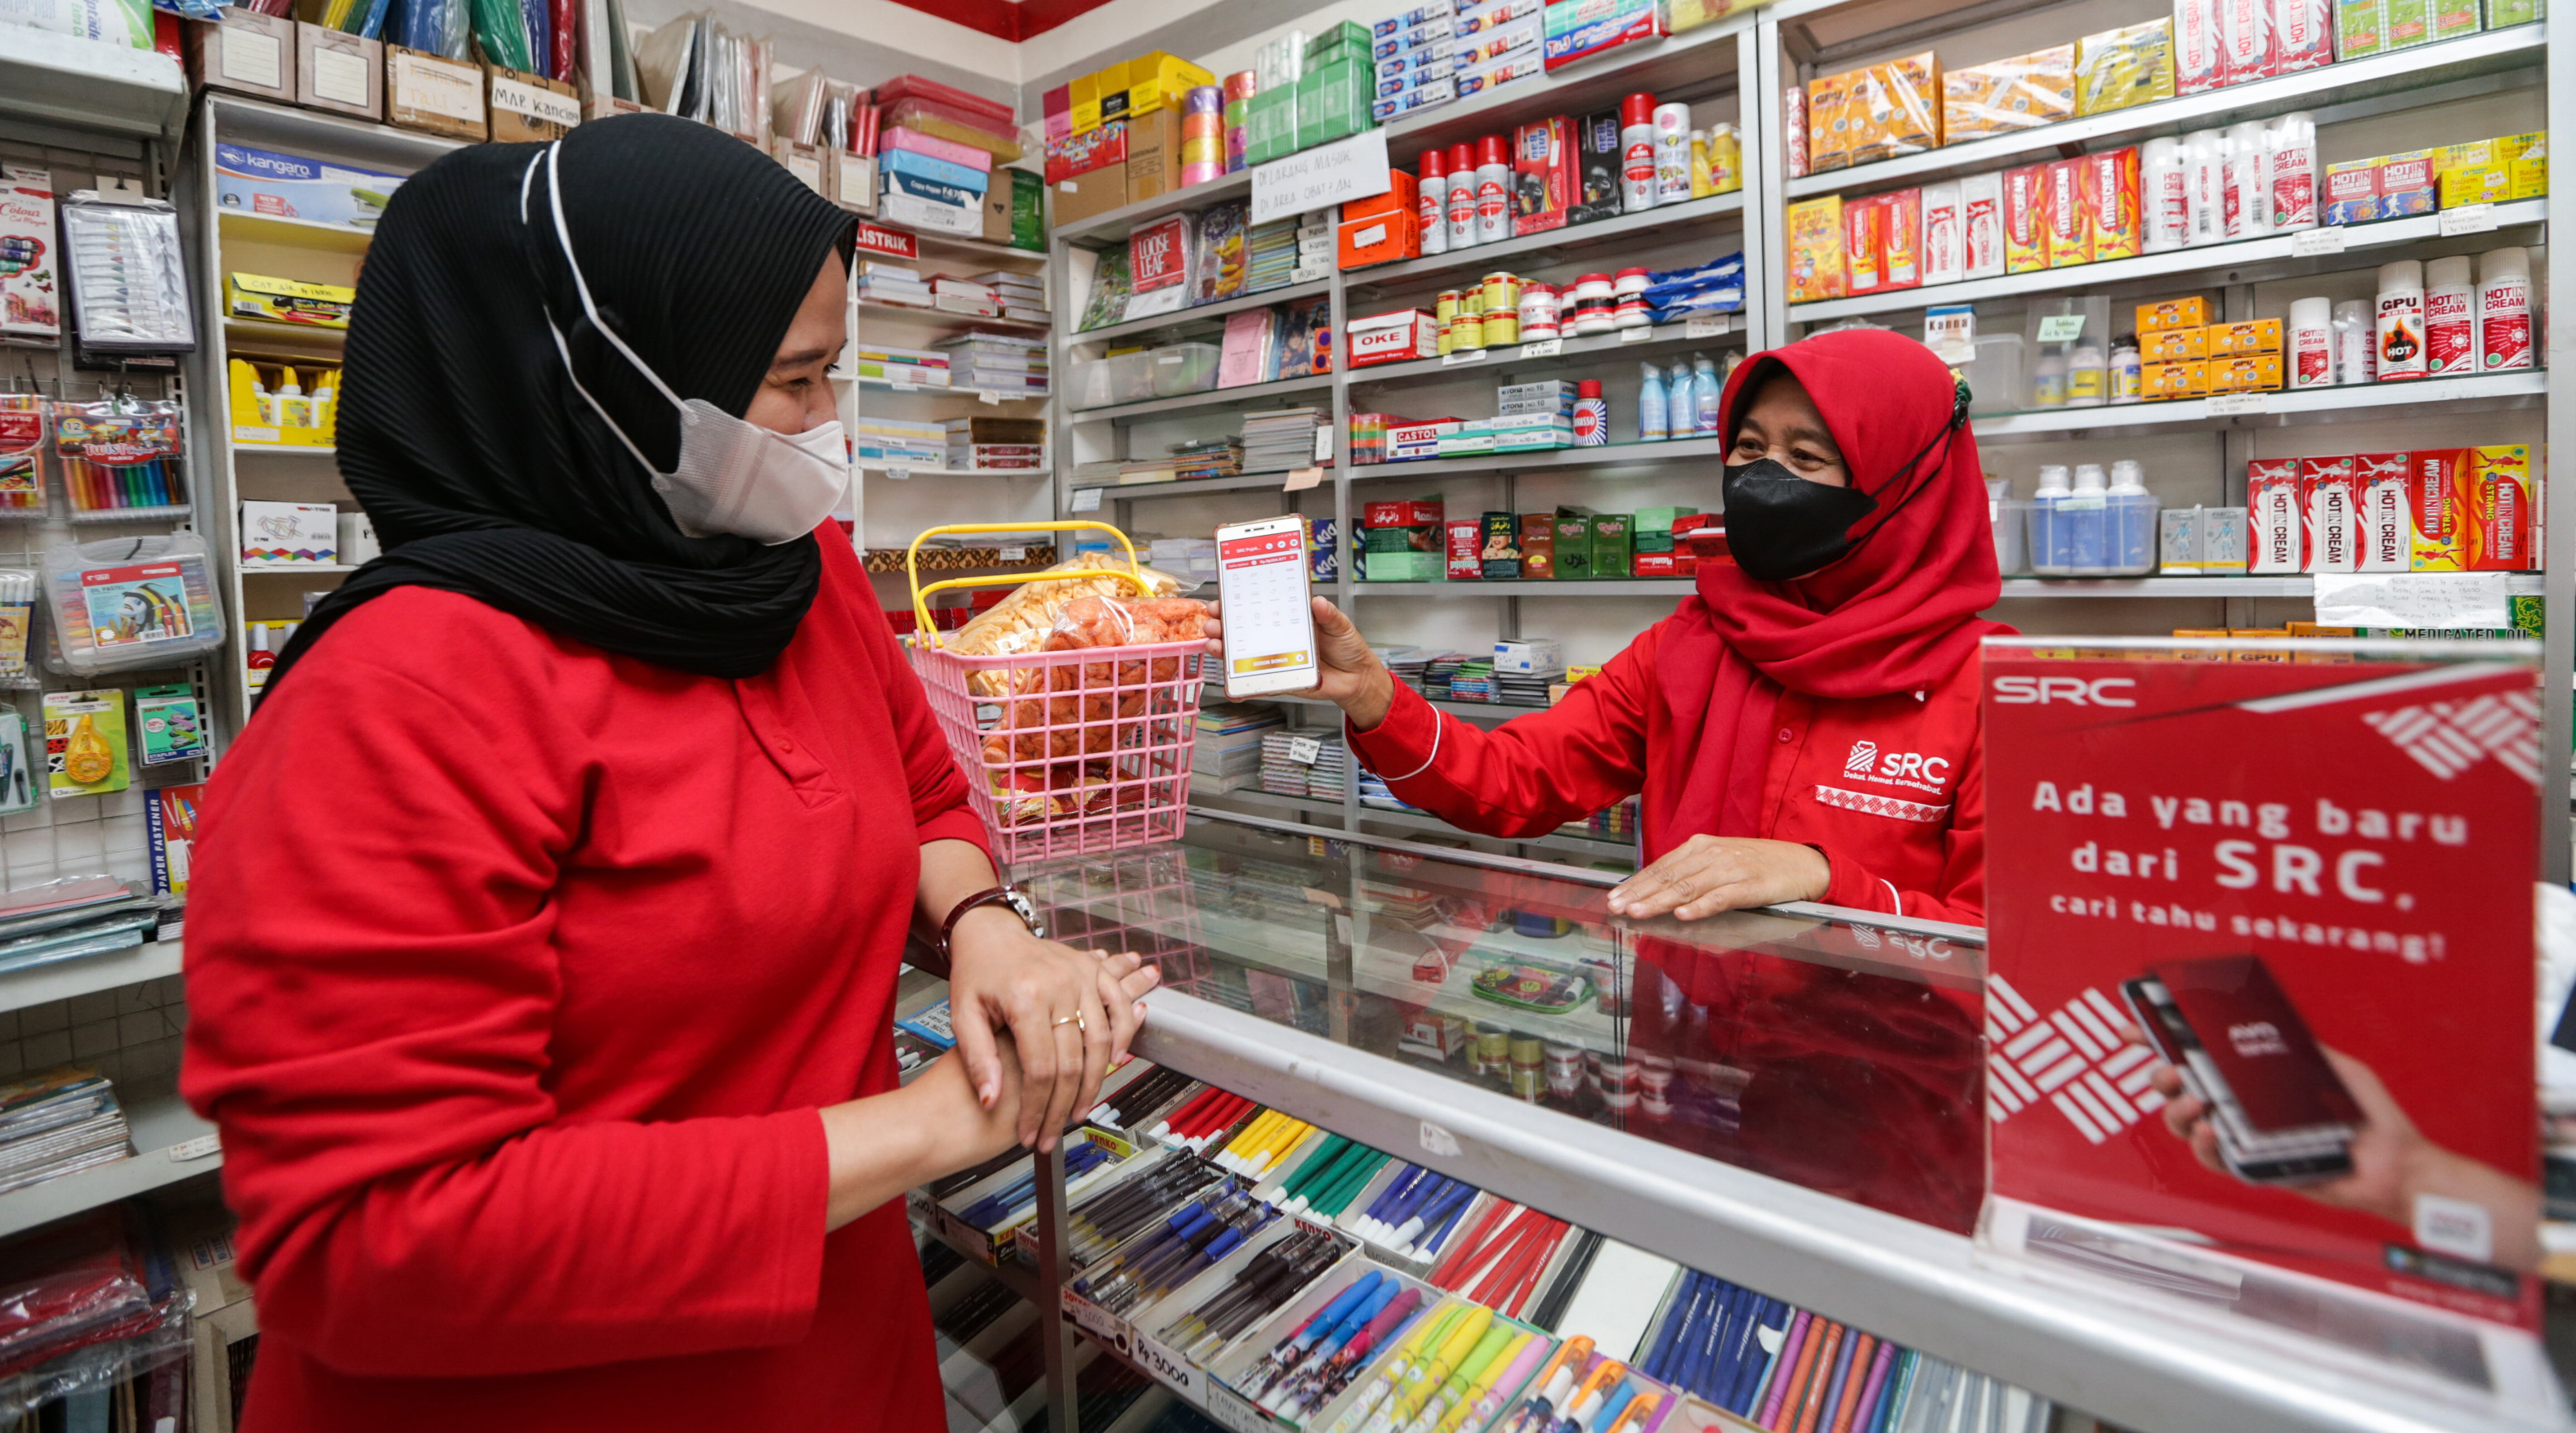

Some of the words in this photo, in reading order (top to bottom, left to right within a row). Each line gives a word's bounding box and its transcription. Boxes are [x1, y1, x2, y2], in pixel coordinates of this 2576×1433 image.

[2438, 16, 2448, 27] 8
[2290, 23, 2304, 44] HOT
[2390, 27, 2400, 38] 8
[2238, 36, 2251, 57] HOT
[2345, 37, 2354, 49] 8
[2188, 48, 2201, 69] HOT
[533, 99, 579, 124] Kancing
[1538, 128, 1549, 155] Anti
[1595, 124, 1608, 153] Bau
[1605, 118, 1617, 148] Anti
[1529, 134, 1539, 159] Bau
[2273, 150, 2295, 163] HOT
[247, 153, 310, 175] kangaro
[2274, 158, 2307, 173] CREAM
[2384, 164, 2411, 177] HOT
[2412, 162, 2426, 172] IN
[2101, 158, 2115, 196] CREAM
[2331, 172, 2357, 186] HOT
[2357, 170, 2371, 181] IN
[2450, 177, 2478, 187] Balsem
[2104, 208, 2116, 228] HOT
[856, 229, 908, 252] LISTRIK
[1138, 232, 1169, 259] LOOSE
[1309, 239, 1329, 250] Kunin
[1140, 254, 1165, 279] LEAF
[2429, 295, 2454, 308] HOT
[2454, 293, 2467, 304] IN
[2485, 287, 2512, 301] HOT
[2512, 286, 2526, 297] IN
[2381, 297, 2417, 311] GPU
[2429, 305, 2466, 316] CREAM
[2485, 298, 2525, 310] CREAM
[1929, 319, 1968, 331] Kanna
[2299, 330, 2315, 338] HOT
[1361, 332, 1400, 345] OKE
[2299, 337, 2325, 346] CREAM
[2387, 346, 2412, 357] HOT
[65, 422, 81, 430] 12
[1398, 429, 1437, 442] CASTOL
[2424, 459, 2440, 498] CREAM
[2274, 494, 2286, 511] HOT
[2328, 492, 2342, 512] HOT
[2381, 490, 2396, 510] HOT
[2498, 483, 2515, 505] HOT
[2425, 501, 2439, 511] IN
[2498, 505, 2513, 518] IN
[2274, 511, 2286, 524] IN
[2328, 513, 2342, 524] IN
[2381, 511, 2395, 523] IN
[2424, 511, 2439, 534] HOT
[2274, 526, 2286, 563] CREAM
[2328, 526, 2342, 563] CREAM
[2381, 524, 2395, 562] CREAM
[2498, 519, 2513, 559] CREAM
[2404, 629, 2495, 640] MEDICATED
[2240, 652, 2282, 664] GPU
[1993, 676, 2137, 708] SRC
[1880, 752, 1950, 784] SRC
[1844, 771, 1867, 782] Dekat.
[1868, 774, 1894, 786] Hemat.
[1895, 778, 1943, 795] Bersahabat.
[2032, 781, 2128, 818] Ada
[2151, 793, 2291, 839] yang
[2316, 798, 2469, 846] baru
[150, 798, 164, 852] FASTENER
[157, 855, 167, 887] PAPER
[2070, 840, 2179, 881] dari
[2214, 839, 2416, 912] SRC.
[2049, 892, 2118, 919] cari
[2131, 899, 2217, 933] tahu
[2231, 913, 2447, 964] sekarang!
[1088, 1133, 1116, 1151] KENKO
[999, 1229, 1016, 1242] KEN
[1294, 1216, 1333, 1243] KENKO
[1137, 1339, 1150, 1362] Rp
[1152, 1349, 1189, 1387] 3000
